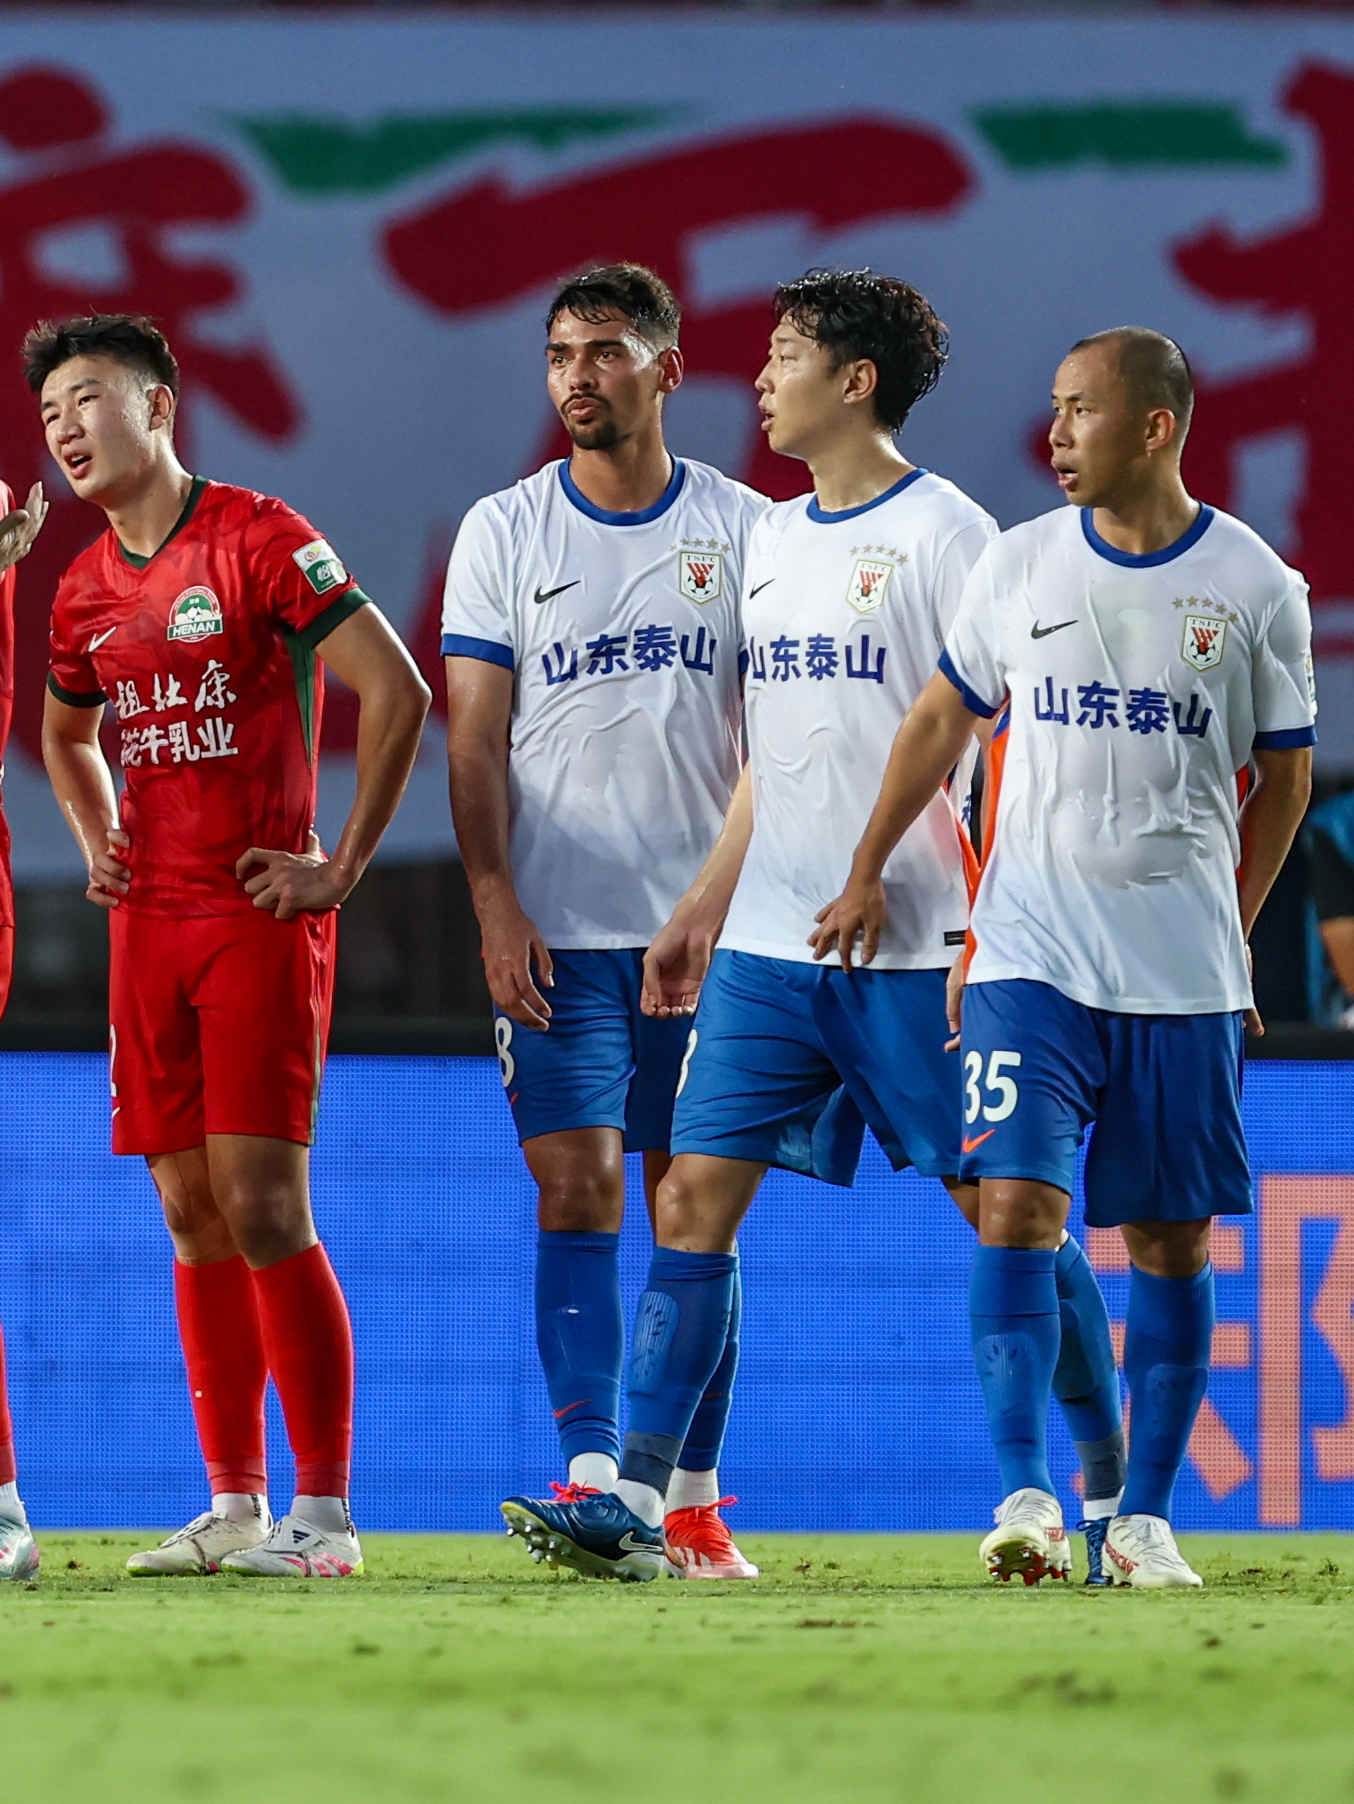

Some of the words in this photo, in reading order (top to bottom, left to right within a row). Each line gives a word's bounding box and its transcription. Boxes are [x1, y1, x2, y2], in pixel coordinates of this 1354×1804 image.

[172, 621, 216, 637] HENAN
[1189, 617, 1223, 629] TSFC
[541, 624, 717, 686] 山东泰山
[102, 659, 237, 720] 祖杜康
[1033, 676, 1212, 738] 山东泰山
[965, 1050, 1021, 1124] 35
